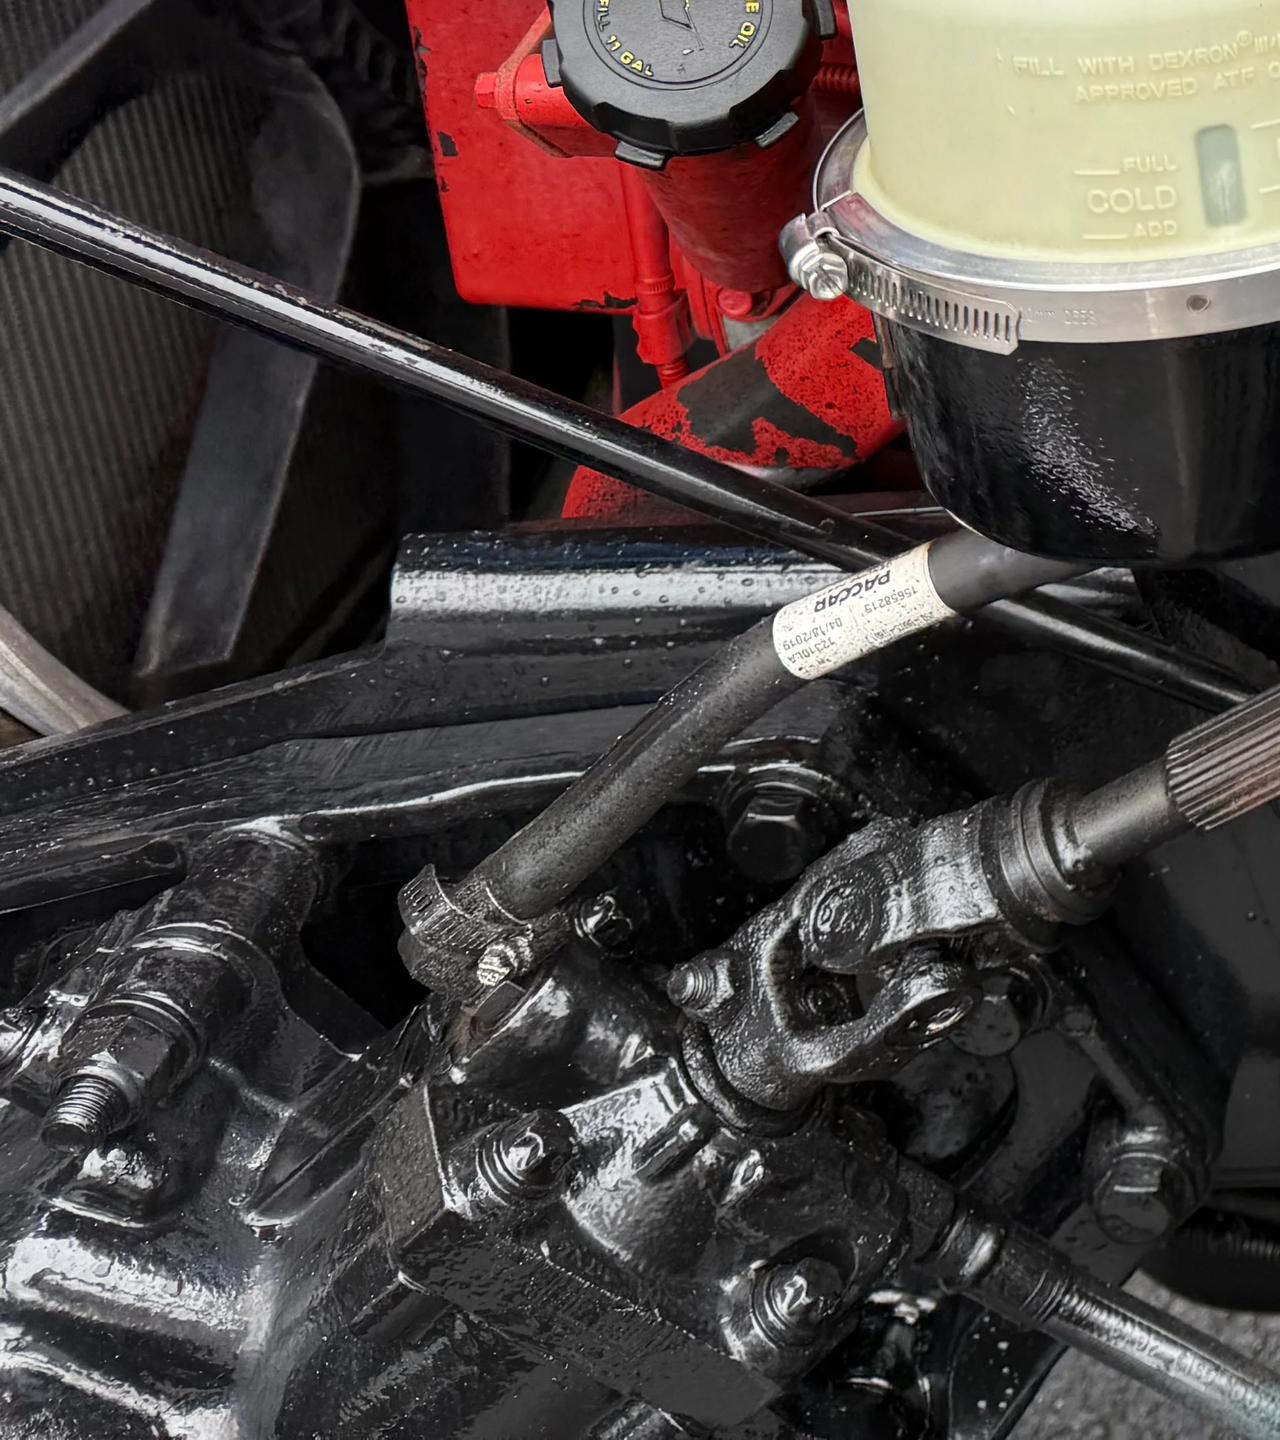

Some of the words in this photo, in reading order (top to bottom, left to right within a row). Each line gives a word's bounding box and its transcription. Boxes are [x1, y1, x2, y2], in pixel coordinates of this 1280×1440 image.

[729, 21, 755, 48] OIL
[620, 51, 653, 77] GAL
[1014, 56, 1064, 75] FILL
[1079, 56, 1134, 74] WITH
[1075, 78, 1197, 103] APPROVED
[1214, 67, 1254, 91] ATF
[1123, 155, 1176, 172] FULL
[1087, 187, 1176, 212] COLD
[1133, 221, 1176, 237] ADD
[814, 569, 891, 613] PACCAR
